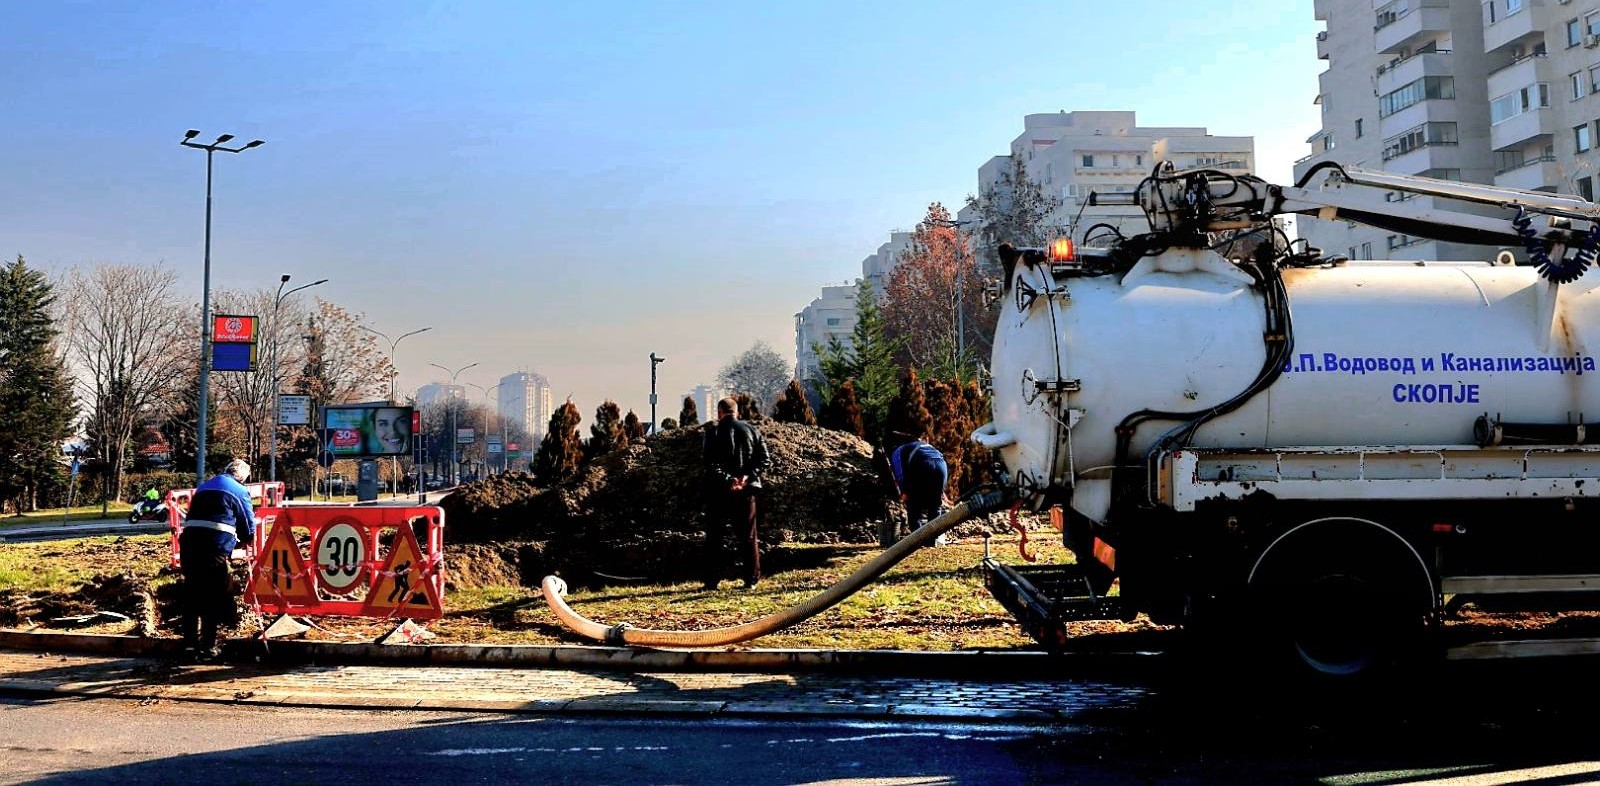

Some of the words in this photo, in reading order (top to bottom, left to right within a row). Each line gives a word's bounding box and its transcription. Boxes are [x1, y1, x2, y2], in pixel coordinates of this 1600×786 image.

[1422, 358, 1435, 372] и
[1442, 352, 1595, 375] Канализација
[1393, 383, 1480, 404] СКОПЈЕ
[326, 536, 359, 577] 30
